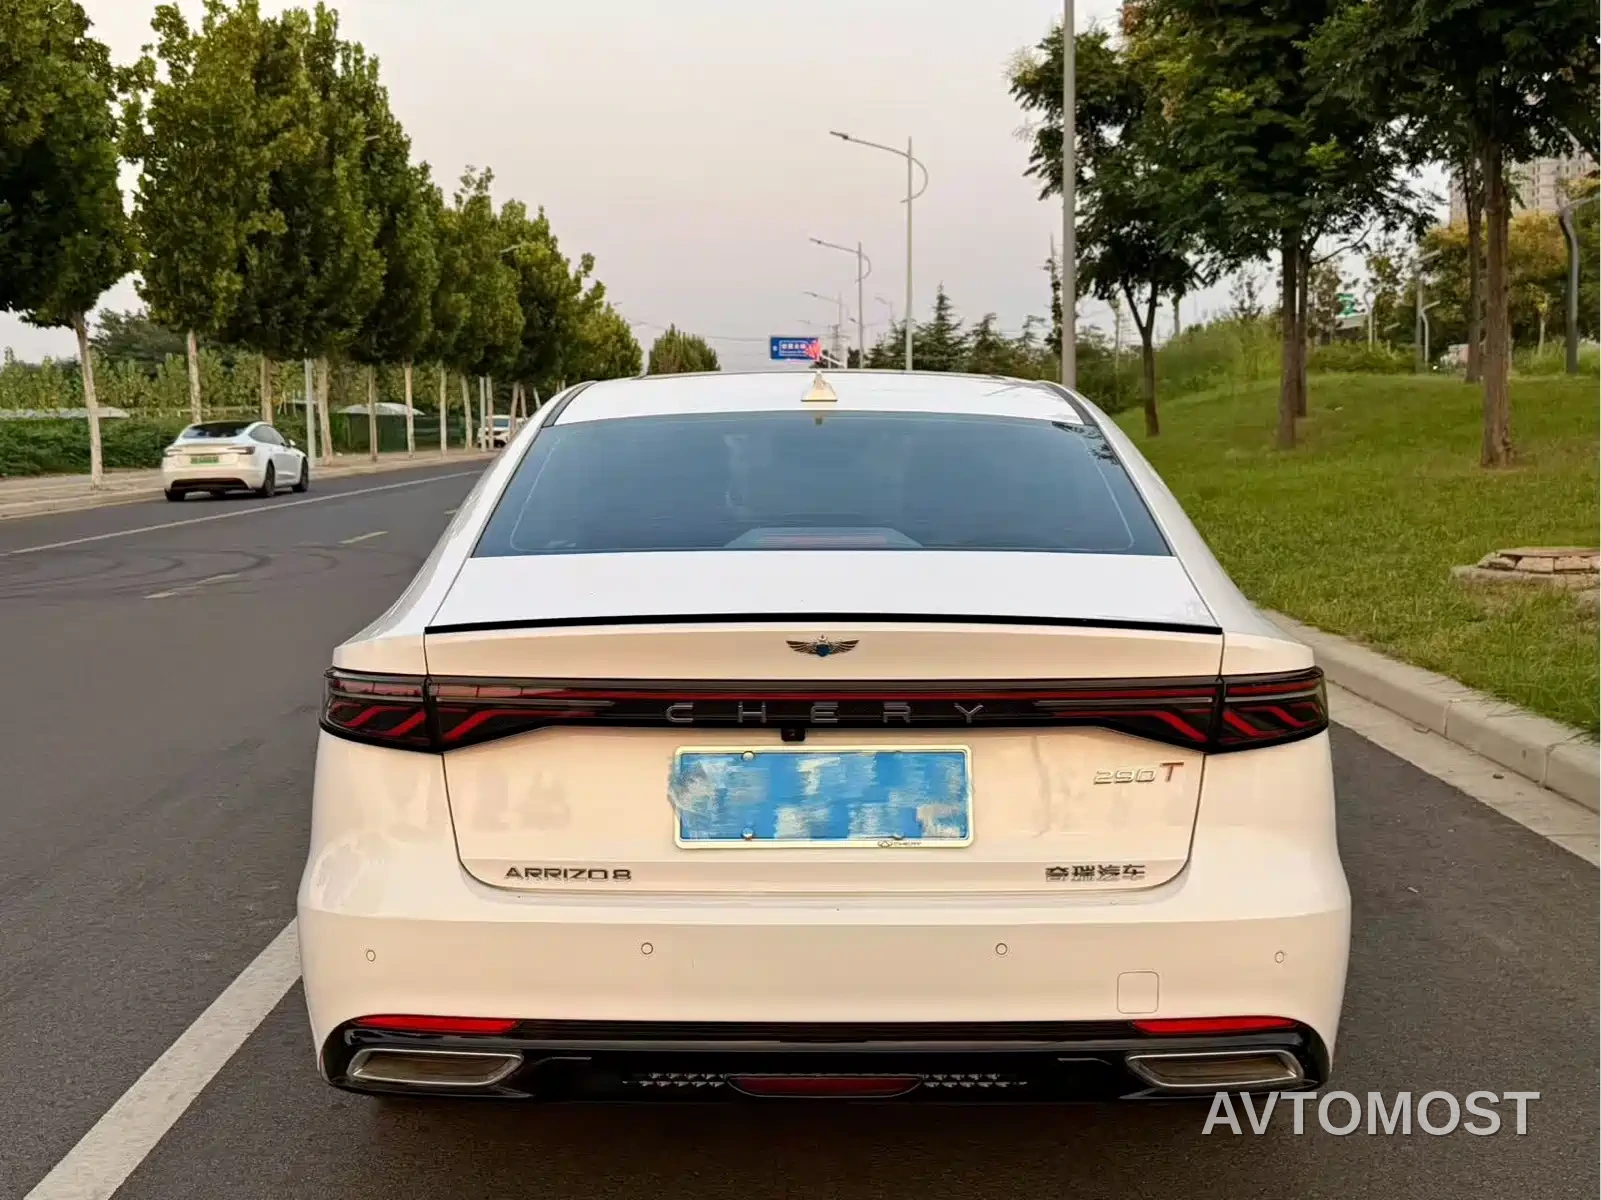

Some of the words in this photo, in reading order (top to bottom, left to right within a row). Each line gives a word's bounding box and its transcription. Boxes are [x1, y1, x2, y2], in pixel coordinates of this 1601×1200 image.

[666, 702, 984, 723] CHERY
[1093, 762, 1184, 785] 290T
[505, 867, 608, 880] ARRIZO
[1045, 864, 1146, 882] 奇瑞汽车
